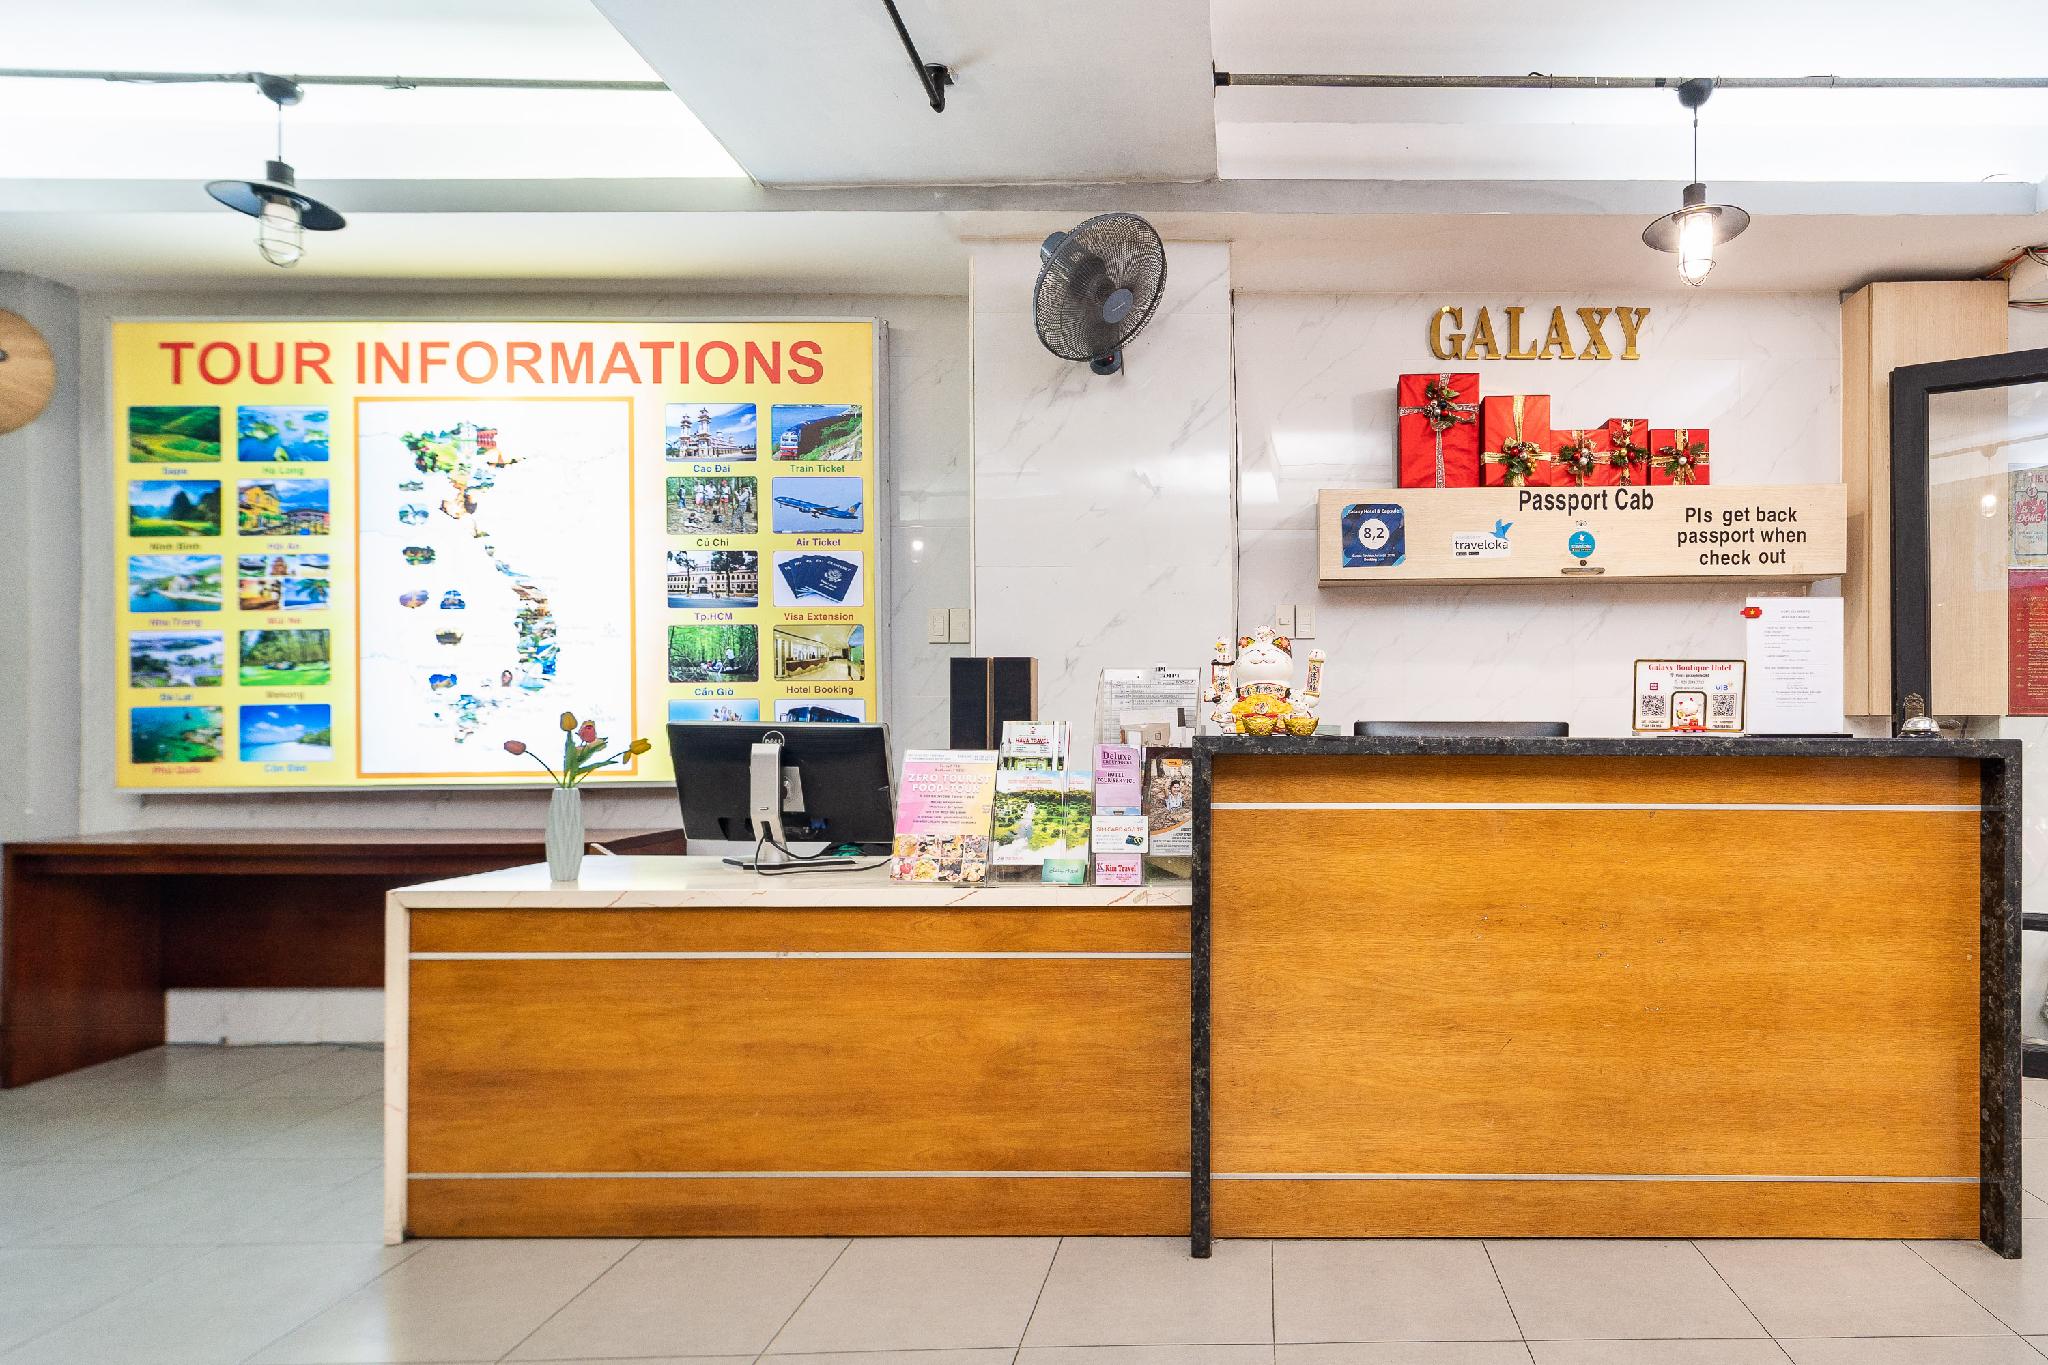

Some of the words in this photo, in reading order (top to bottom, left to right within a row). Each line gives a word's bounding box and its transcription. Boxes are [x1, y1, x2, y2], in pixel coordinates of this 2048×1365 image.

[1429, 305, 1650, 360] GALAXY
[159, 341, 335, 385] TOUR
[356, 340, 824, 385] INFORMATIONS
[790, 464, 814, 473] Train
[817, 464, 845, 473] Ticket
[1519, 490, 1608, 516] Passport
[1614, 488, 1654, 510] Cab
[1685, 508, 1713, 523] Pls
[1722, 507, 1750, 526] get
[1756, 506, 1798, 522] back
[1364, 528, 1384, 540] 8,2
[1677, 528, 1755, 547] passport
[1761, 527, 1807, 543] when
[712, 538, 729, 547] Chi
[796, 538, 809, 546] Air
[812, 538, 841, 546] Ticket
[1454, 540, 1509, 550] traveloka
[1699, 549, 1750, 565] check
[1758, 549, 1786, 564] out
[694, 613, 733, 622] Tp.HCM
[784, 613, 804, 621] Visa
[807, 613, 854, 621] Extension
[786, 686, 810, 694] Hotel
[814, 686, 854, 695] Booking
[1103, 751, 1132, 761] Deluxe
[908, 773, 938, 782] ZERO
[942, 774, 991, 784] TOURIST
